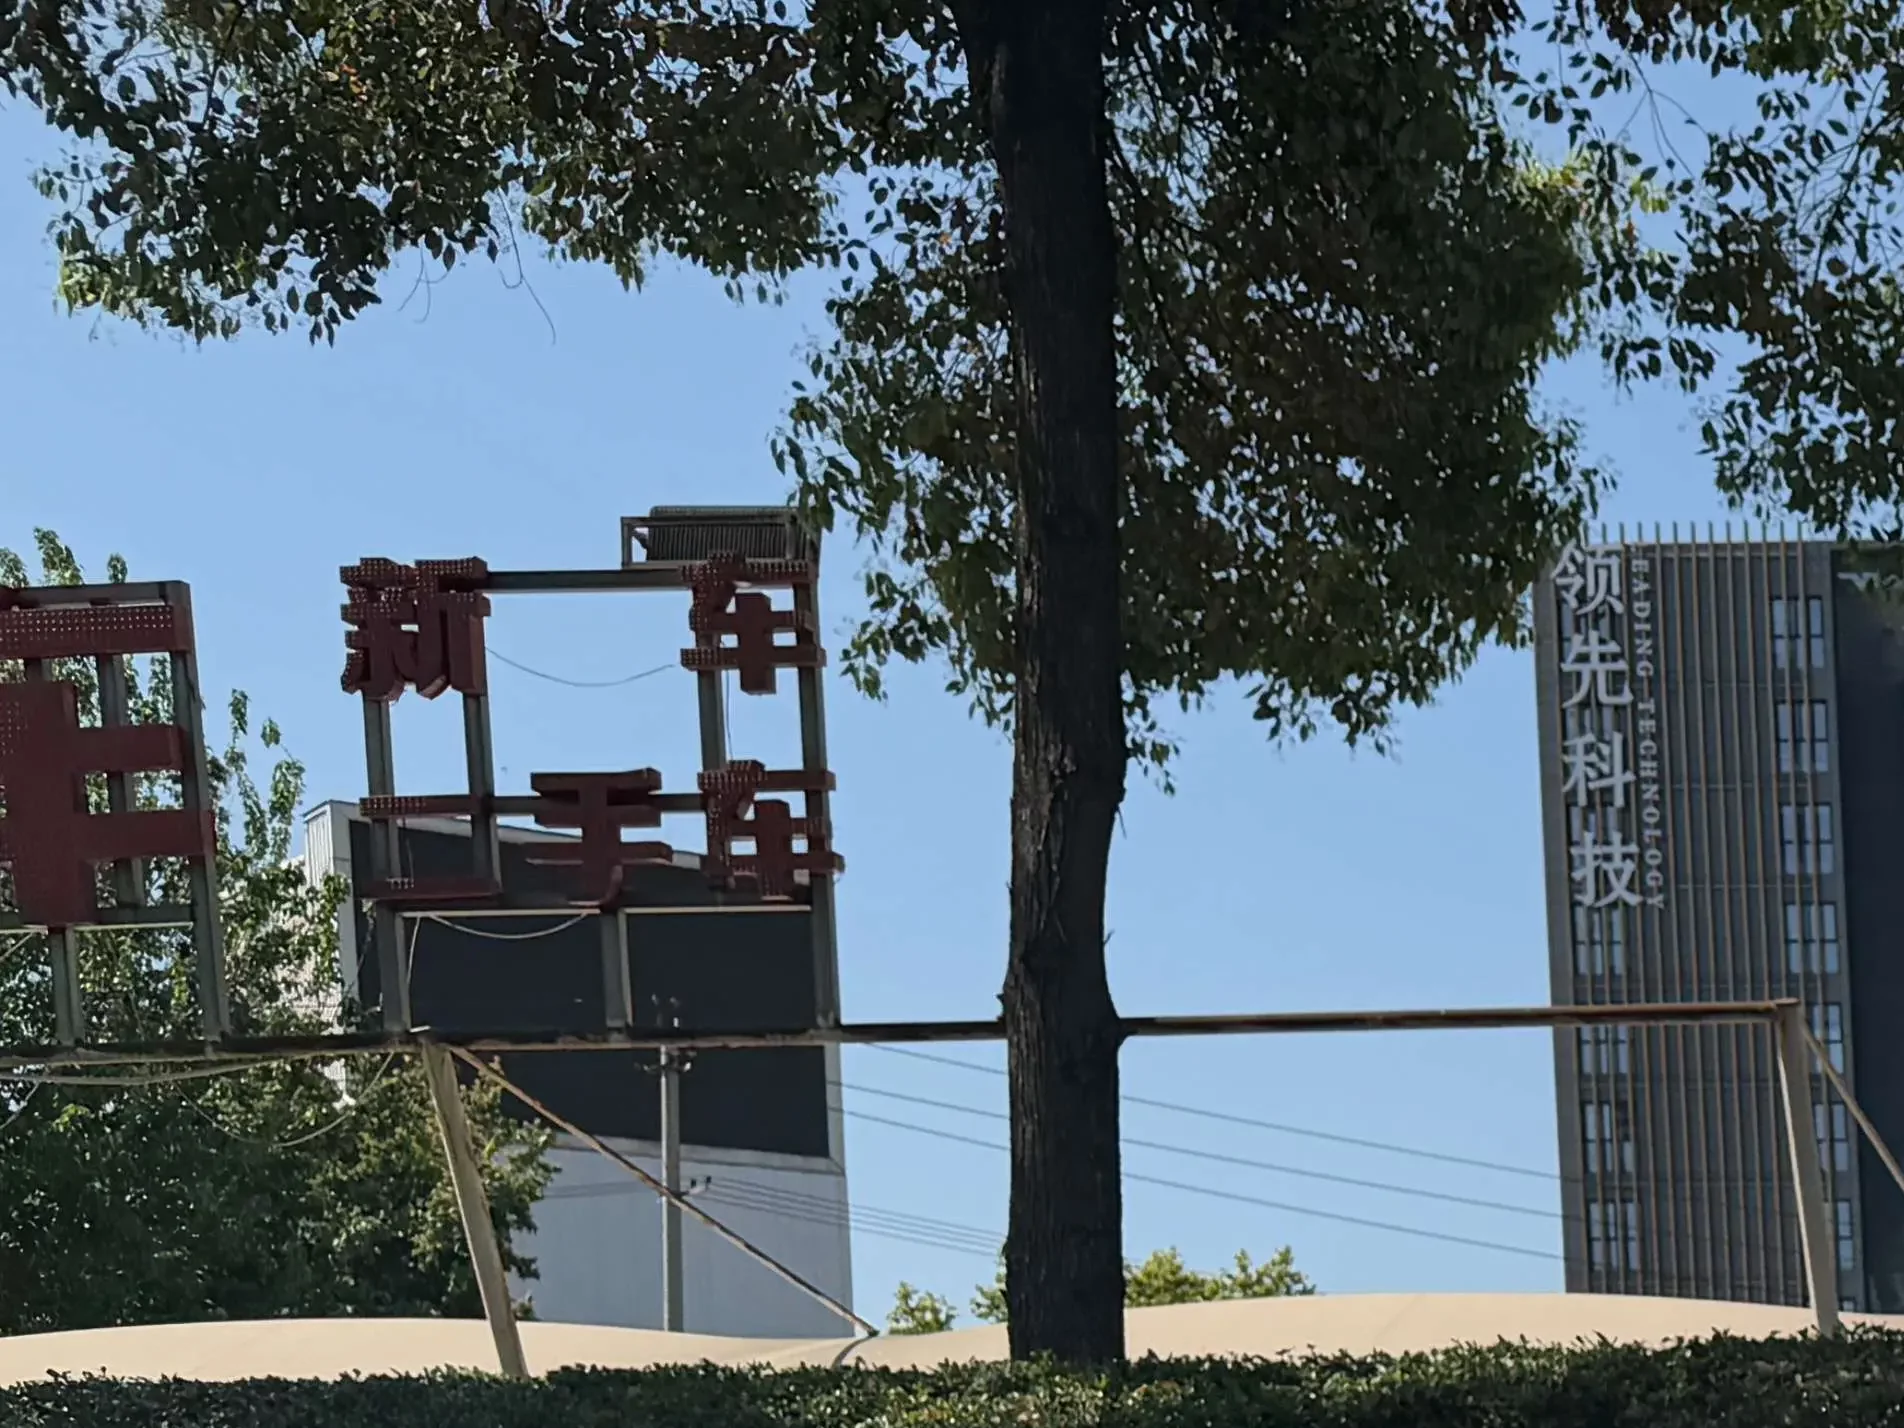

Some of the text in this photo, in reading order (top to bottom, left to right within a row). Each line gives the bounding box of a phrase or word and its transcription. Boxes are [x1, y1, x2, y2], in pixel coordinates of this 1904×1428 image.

[1550, 537, 1645, 908] 领先科技
[1631, 542, 1665, 910] EADING TECHNOLOGY
